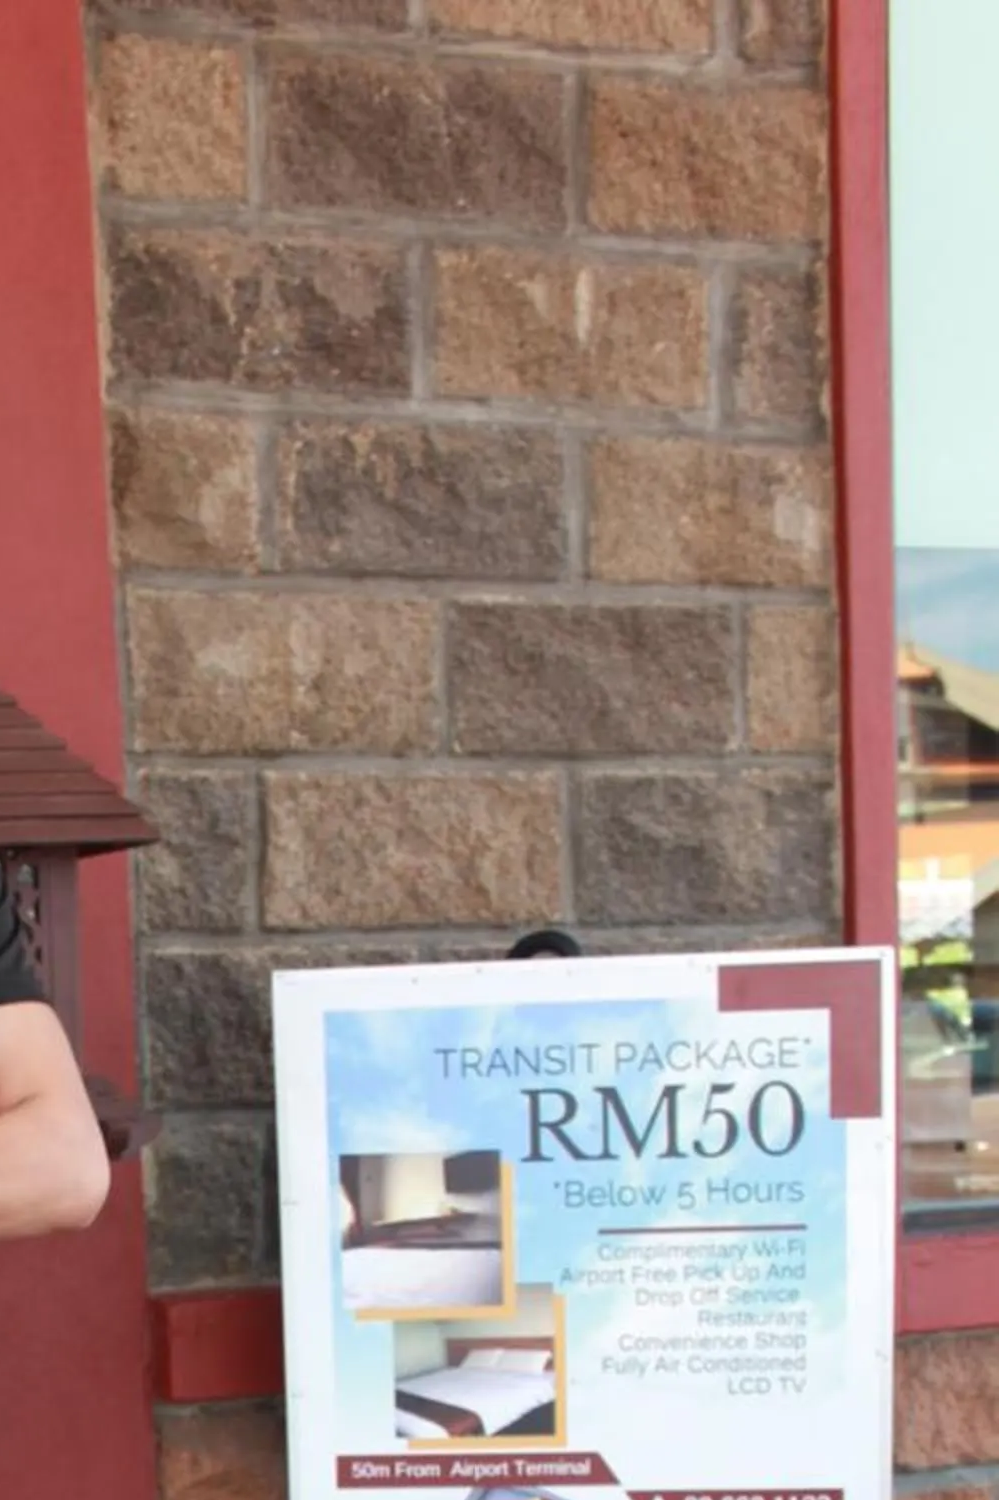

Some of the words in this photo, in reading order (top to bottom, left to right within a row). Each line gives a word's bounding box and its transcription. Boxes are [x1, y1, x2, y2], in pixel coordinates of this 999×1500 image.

[435, 1043, 600, 1079] TRANSIT
[520, 1080, 805, 1162] RM50
[677, 1182, 697, 1210] 5
[706, 1177, 805, 1205] Hours
[598, 1242, 748, 1262] Complimentary
[559, 1266, 625, 1286] Airport
[632, 1265, 677, 1283] Free
[683, 1263, 725, 1282] Pick
[732, 1264, 760, 1283] Up
[766, 1262, 806, 1281] And
[634, 1287, 684, 1308] Drop
[689, 1286, 720, 1306] Off
[726, 1285, 800, 1304] Service
[697, 1309, 807, 1327] Restaurant
[617, 1332, 749, 1351] Convenience
[755, 1331, 807, 1350] Shop
[601, 1356, 649, 1377] Fully
[654, 1356, 680, 1374] Air
[687, 1355, 807, 1374] Conditioned
[727, 1376, 772, 1396] LCD
[779, 1375, 807, 1394] TV
[351, 1462, 390, 1478] 50m
[394, 1460, 441, 1478] From
[449, 1459, 509, 1481] Airport
[514, 1459, 592, 1477] Terminal
